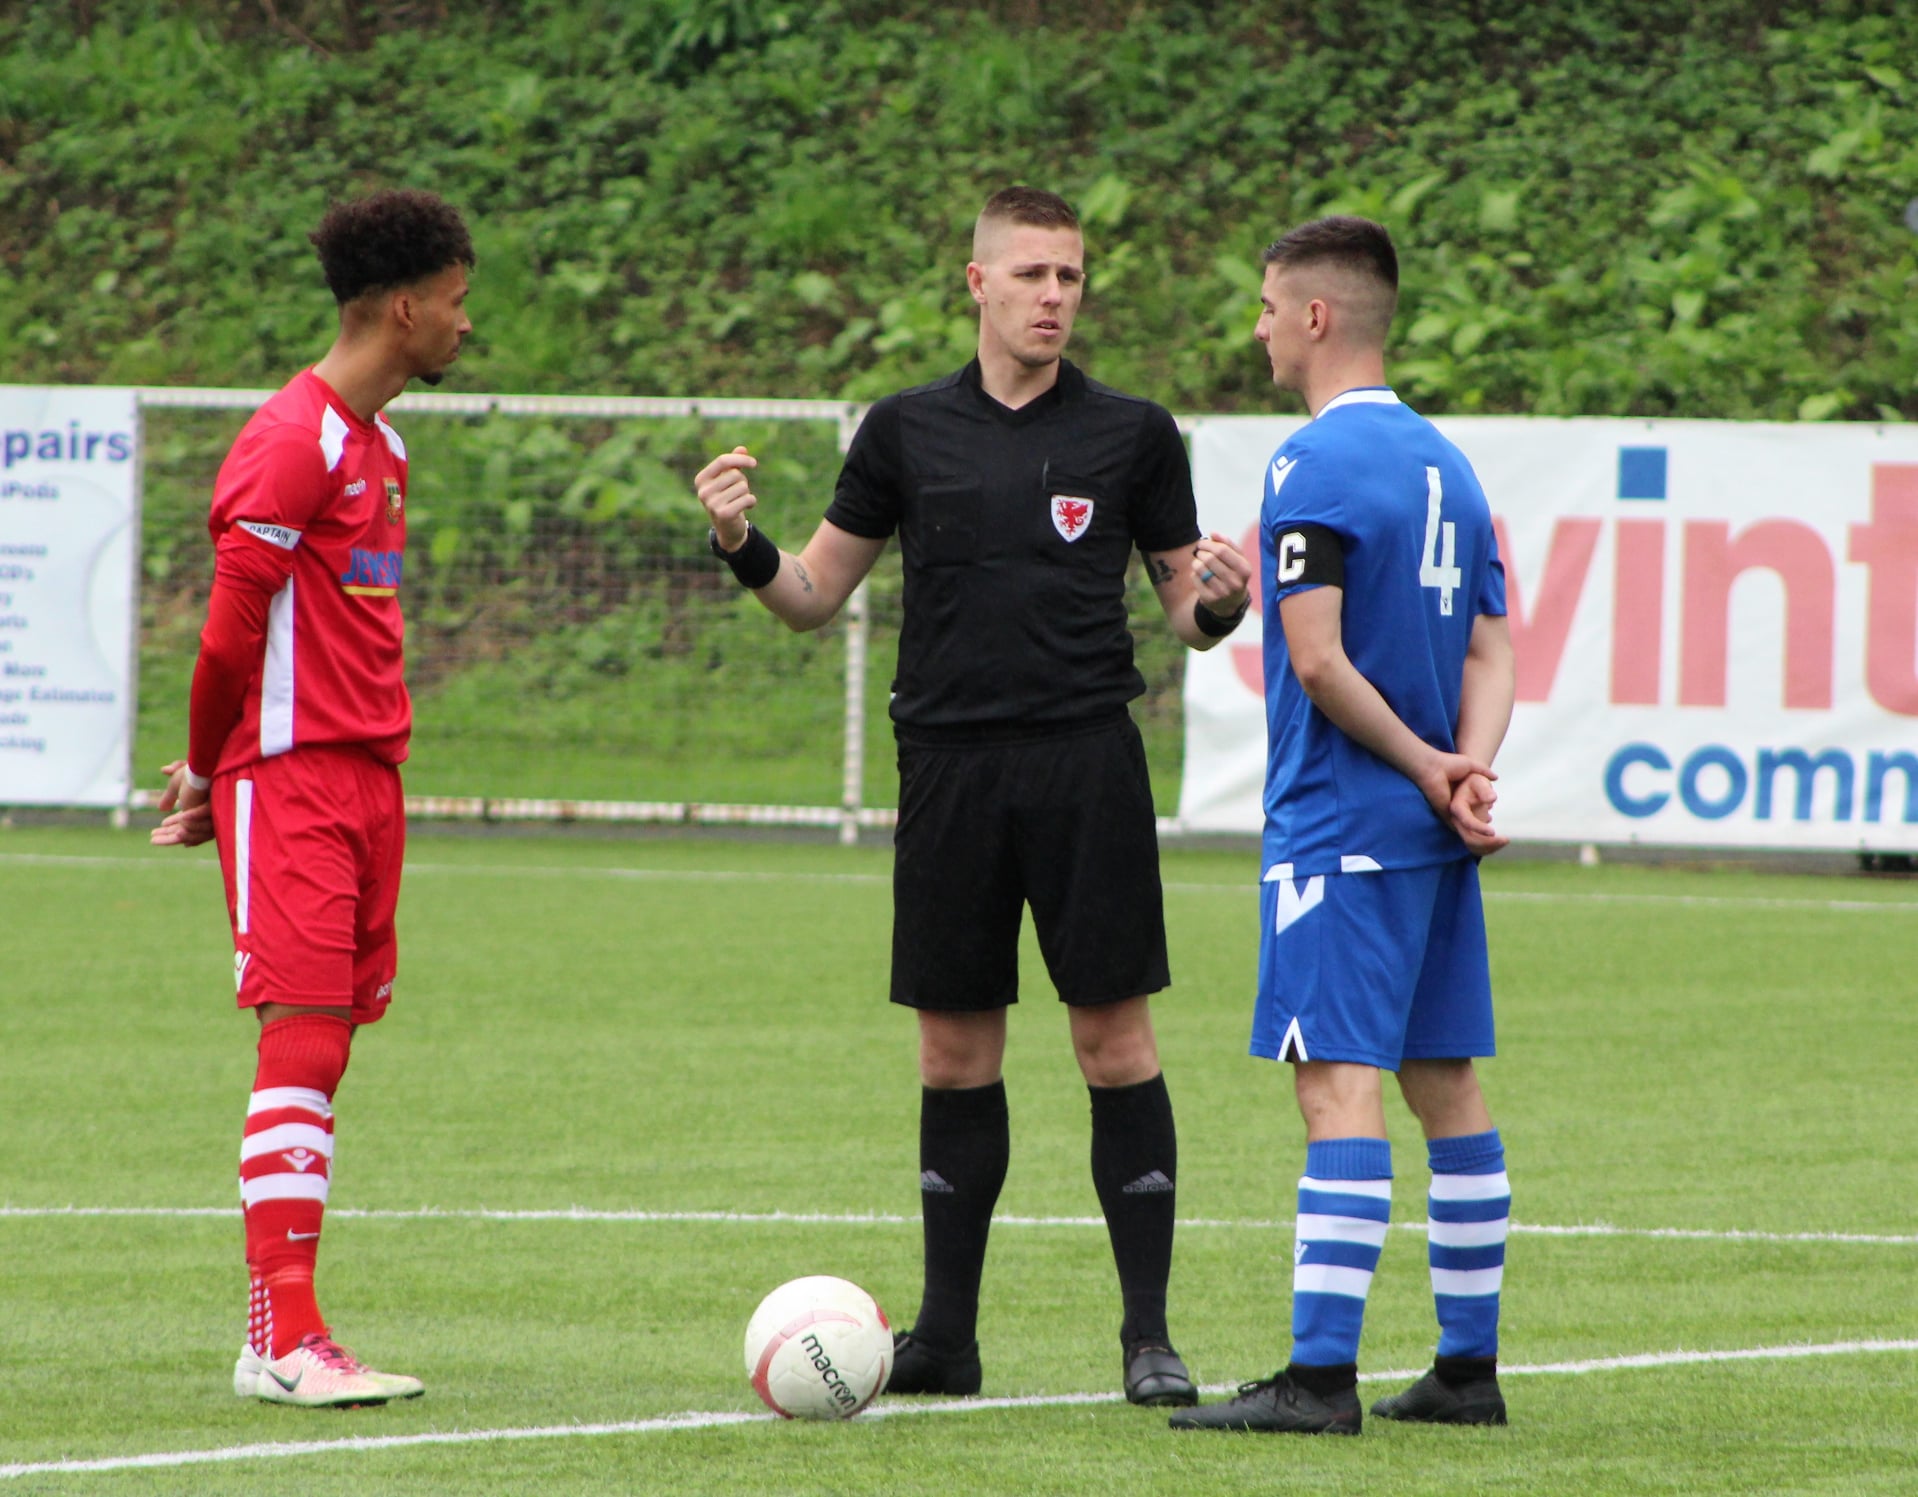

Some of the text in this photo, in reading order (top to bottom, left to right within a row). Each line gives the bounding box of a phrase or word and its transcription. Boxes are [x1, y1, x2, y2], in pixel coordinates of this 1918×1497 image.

[4, 420, 132, 469] pairs
[248, 524, 292, 545] CAPTAIN
[1277, 531, 1307, 583] C
[1418, 466, 1462, 616] 4
[800, 1332, 858, 1412] macron
